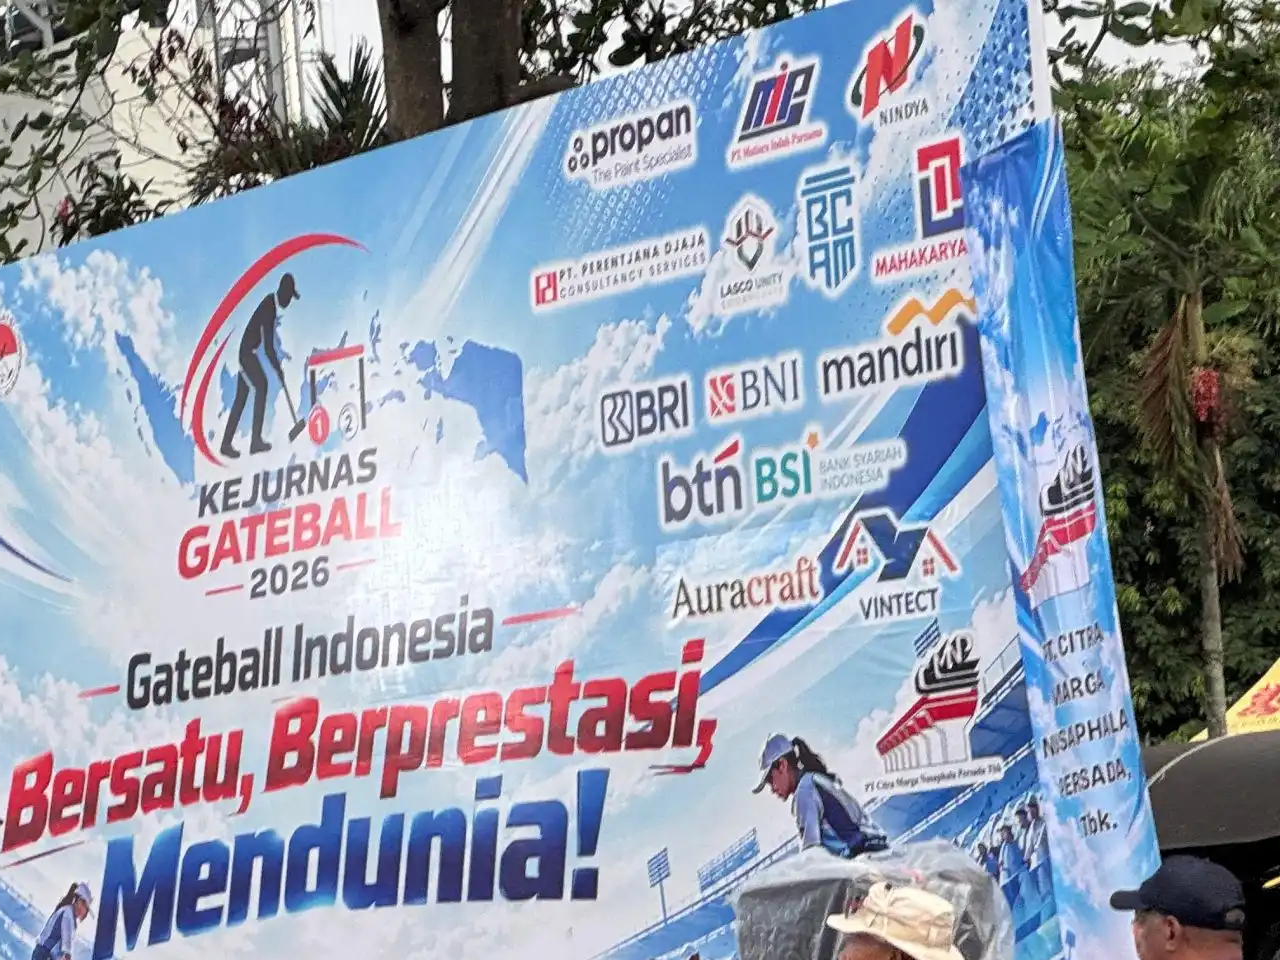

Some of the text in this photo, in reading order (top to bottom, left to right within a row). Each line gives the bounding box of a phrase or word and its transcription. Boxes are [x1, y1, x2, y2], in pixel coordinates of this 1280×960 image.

[591, 104, 691, 166] propan
[880, 97, 929, 126] NINDYA
[559, 232, 706, 281] PT. PERENTJANA DJAJA
[560, 252, 706, 299] CONSULTANCY SERVICES
[721, 279, 753, 298] LASCO
[754, 272, 783, 289] UNITY
[875, 237, 969, 277] MAHAKARYA
[741, 357, 800, 411] BNI
[823, 327, 958, 395] mandiri
[636, 380, 689, 437] BRI
[197, 447, 378, 518] KEJURNAS
[664, 446, 743, 523] btn
[755, 446, 812, 504] BSI
[853, 445, 902, 466] SYARIAH
[178, 485, 402, 579] GATEBALL
[250, 554, 330, 600] 2026
[672, 555, 819, 620] Auracraft
[859, 587, 938, 621] VINTECT
[126, 595, 495, 711] Gateball Indonesia
[2, 638, 718, 854] Bersatu, Berprestasi,
